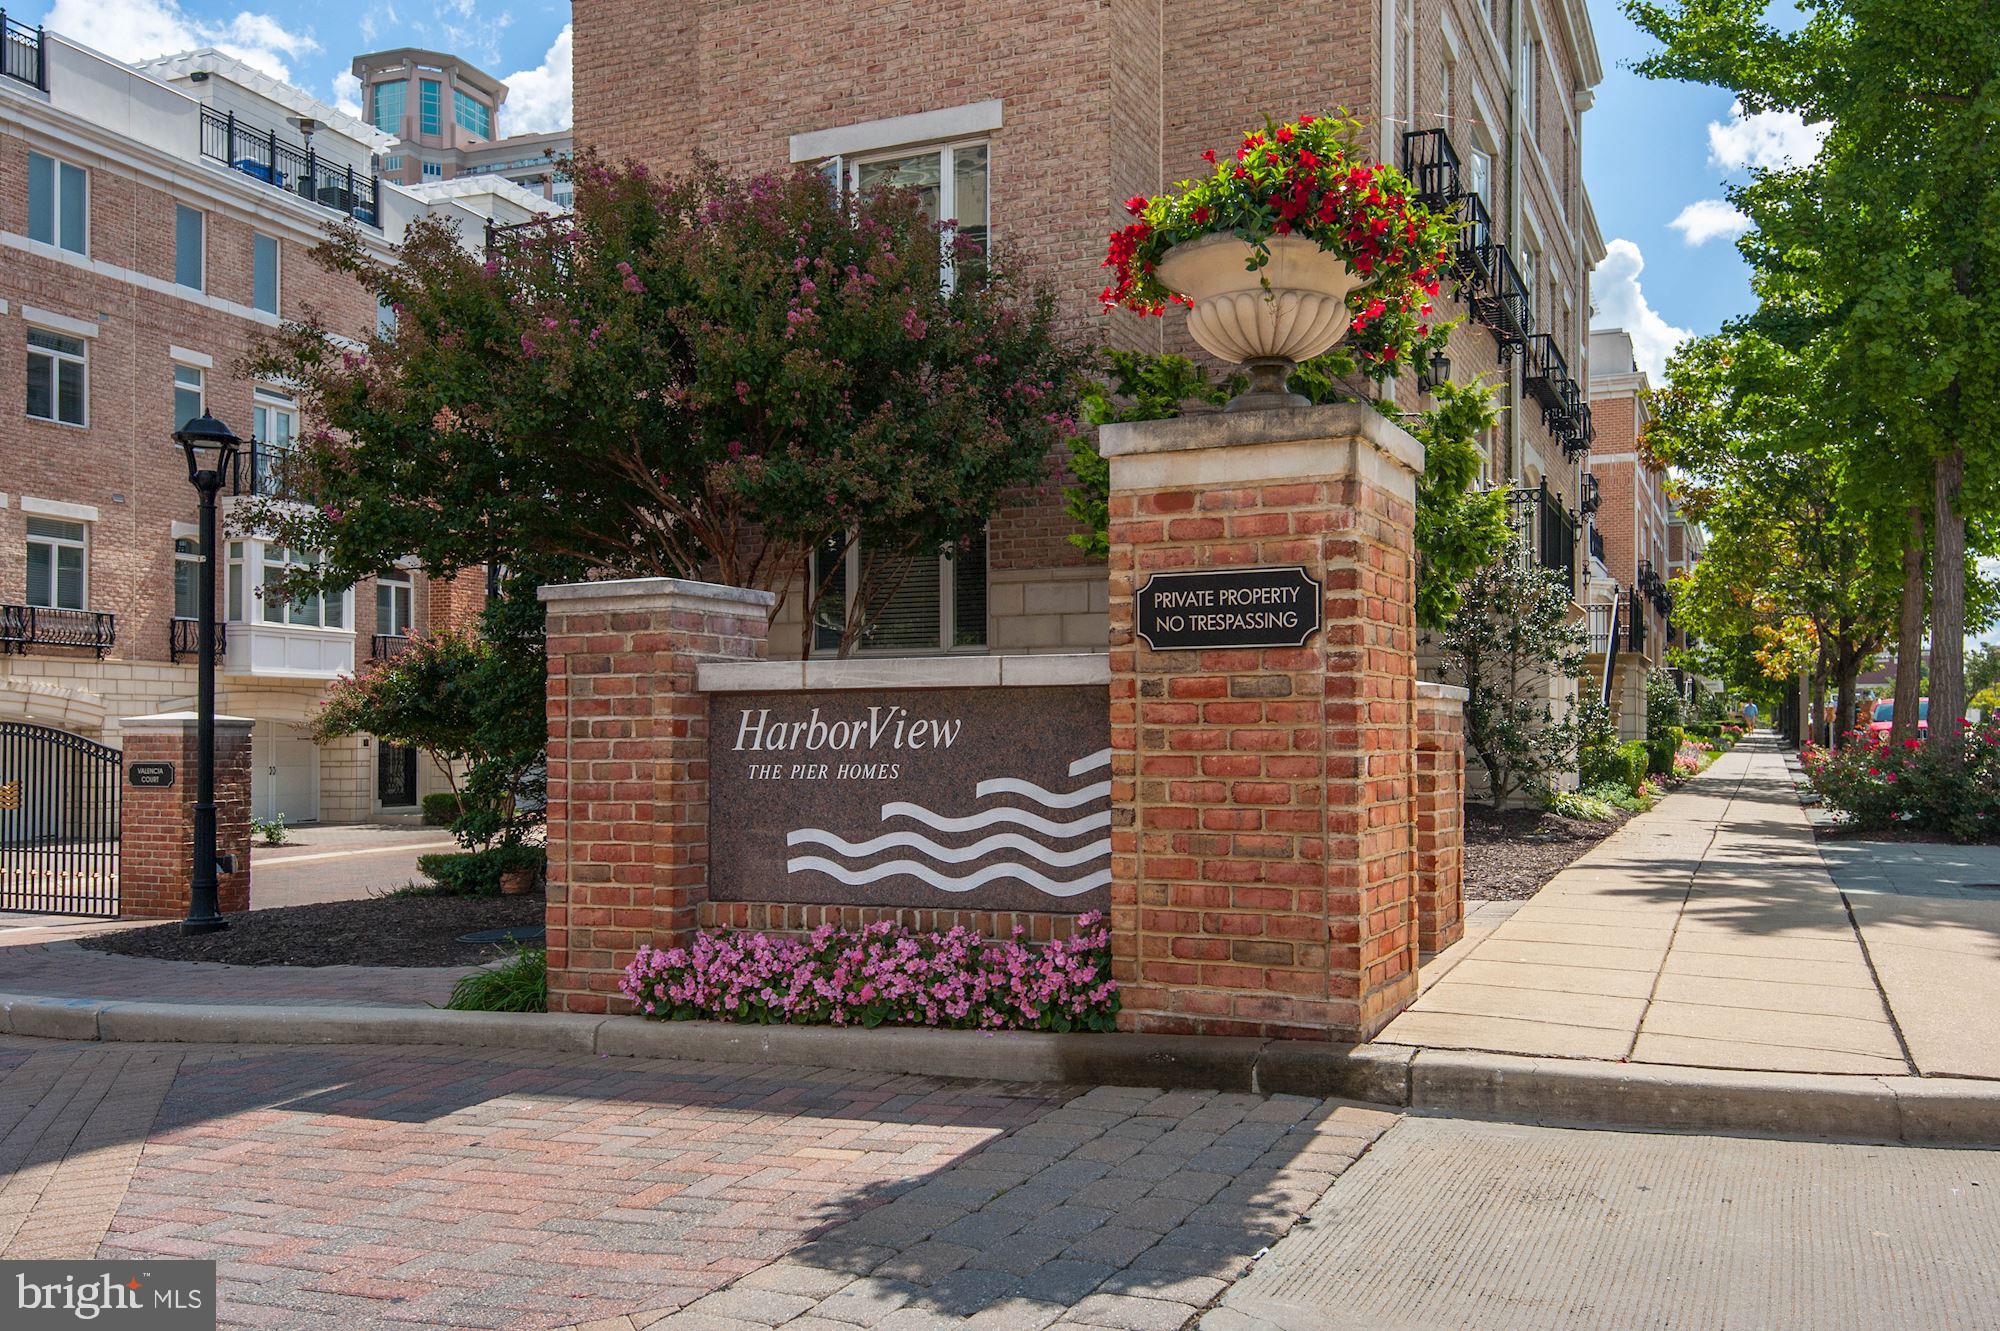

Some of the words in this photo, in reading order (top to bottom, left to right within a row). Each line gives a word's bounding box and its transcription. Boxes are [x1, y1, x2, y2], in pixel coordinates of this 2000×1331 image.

[1154, 590, 1214, 608] PRIVATE
[1219, 586, 1300, 606] PROPERTY
[1156, 615, 1185, 632] NO
[1189, 611, 1298, 631] TRESPASSING
[732, 706, 961, 751] HarborView
[137, 767, 164, 775] VALENCIA
[748, 764, 782, 779] THE
[791, 764, 829, 779] PIER
[837, 764, 900, 779] HOMES
